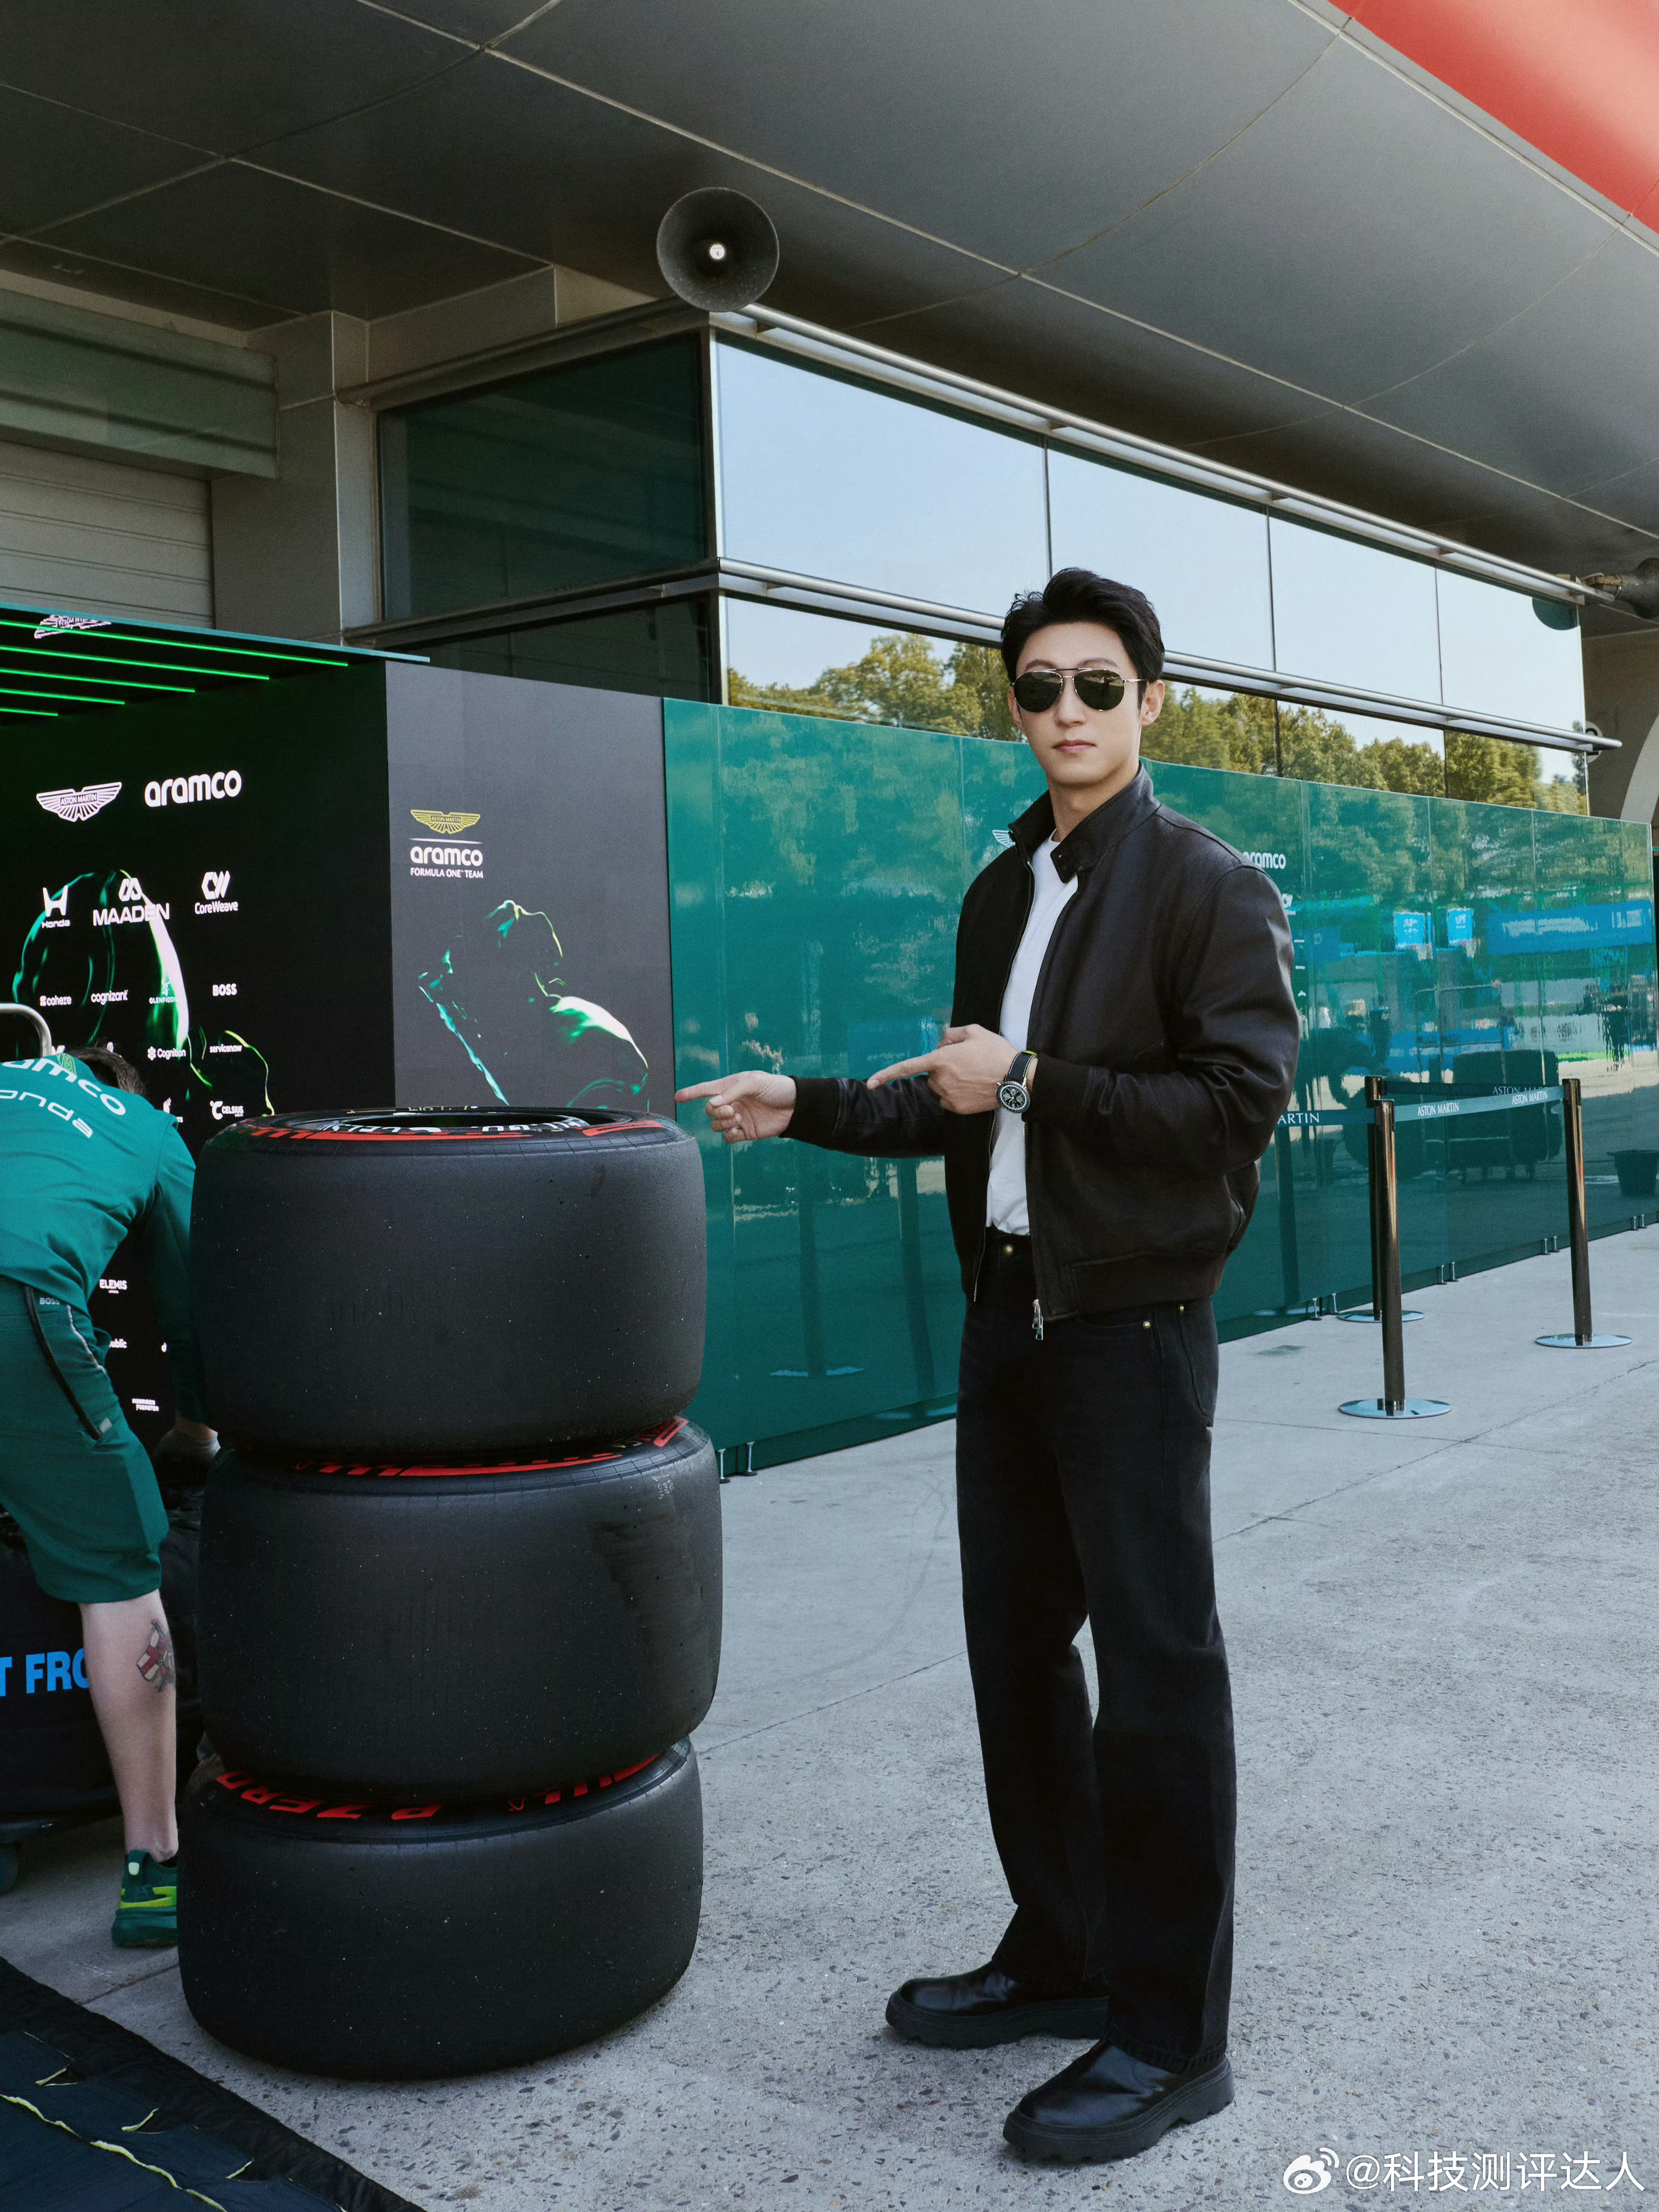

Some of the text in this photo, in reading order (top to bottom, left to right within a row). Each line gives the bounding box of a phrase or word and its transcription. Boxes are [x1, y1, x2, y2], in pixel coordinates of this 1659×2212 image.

[144, 770, 242, 807] aramco
[60, 793, 97, 805] ASTON MARTIN
[410, 846, 483, 866] aramco
[410, 867, 445, 877] FORMULA
[465, 870, 483, 879] TEAM
[195, 900, 238, 914] CoreWeave
[93, 902, 170, 926] MAADEN
[42, 919, 70, 928] Honda
[212, 983, 237, 996] BOSS
[91, 990, 128, 1005] cognizant
[157, 1048, 186, 1060] Cognition
[209, 1044, 242, 1053] servicenow
[2, 1058, 126, 1115] amco
[1512, 1090, 1548, 1105] ASTON MARTIN
[0, 1090, 93, 1138] onda
[221, 1105, 244, 1114] CELSIUS
[1417, 1102, 1460, 1117] ASTON MARTIN
[1277, 1112, 1319, 1124] ARTIN
[99, 1279, 127, 1290] ELEMIS
[109, 1338, 127, 1348] ublic
[26, 1647, 89, 1694] FRO
